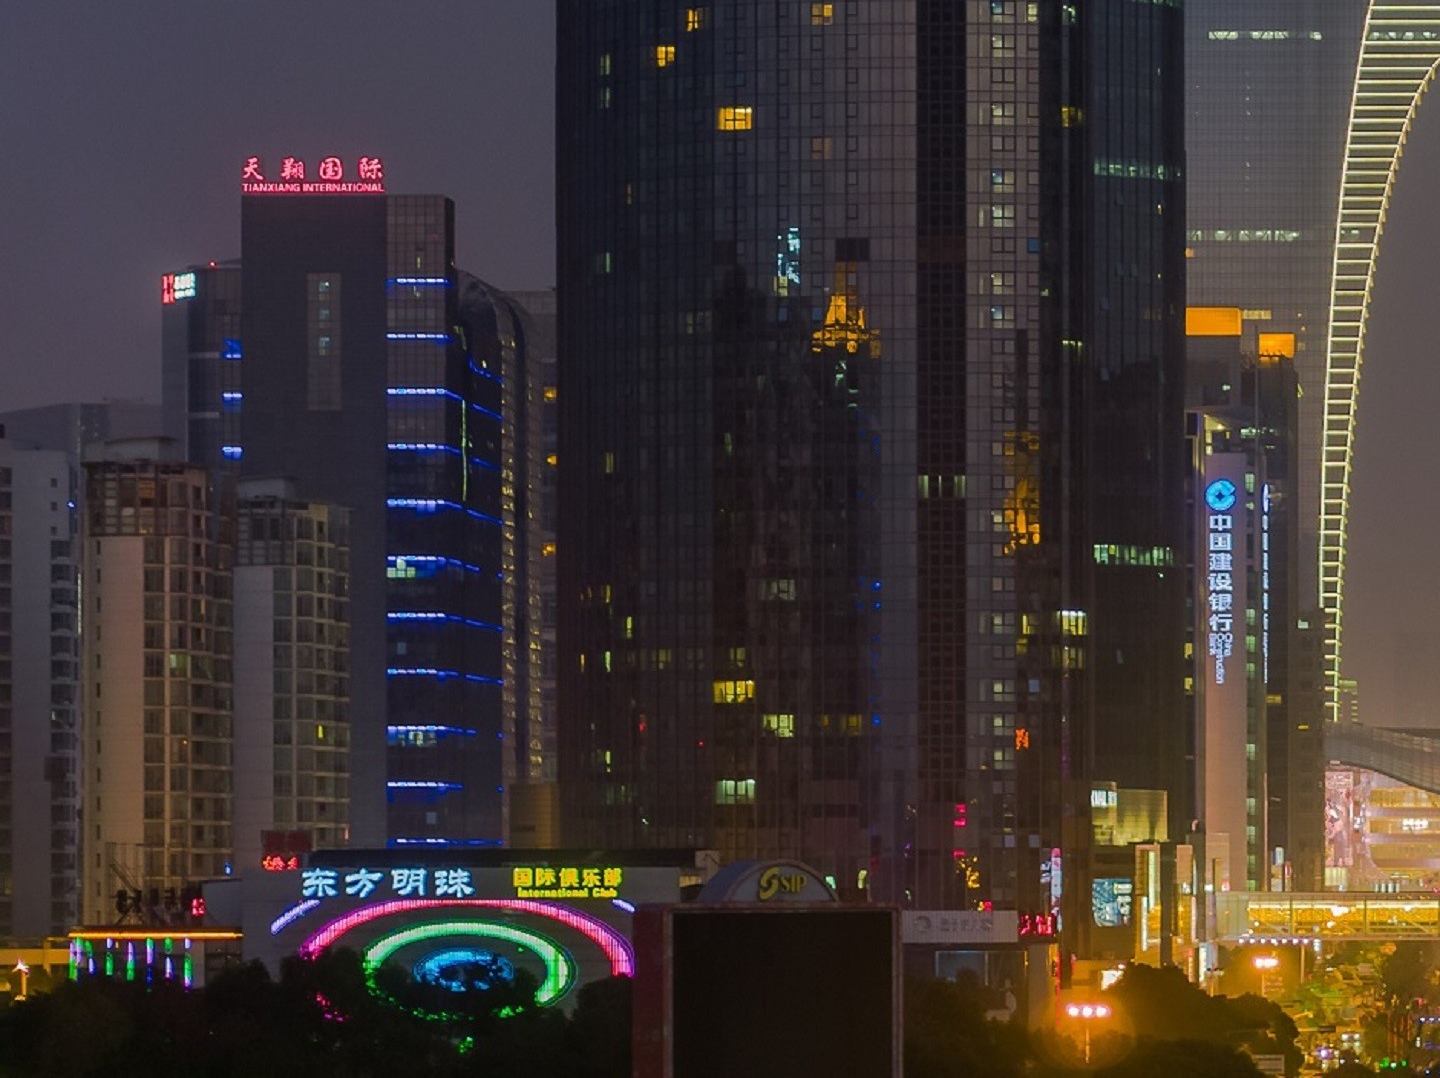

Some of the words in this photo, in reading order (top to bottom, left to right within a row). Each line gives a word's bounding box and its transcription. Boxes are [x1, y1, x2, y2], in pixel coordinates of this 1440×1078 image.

[242, 156, 383, 180] 天翔国际
[241, 182, 301, 193] TIANXIANG
[302, 182, 385, 193] INTERNATIONAL
[1208, 514, 1233, 632] 中国建设银行
[301, 867, 476, 898] 东方明珠
[512, 867, 622, 888] 国际俱乐部
